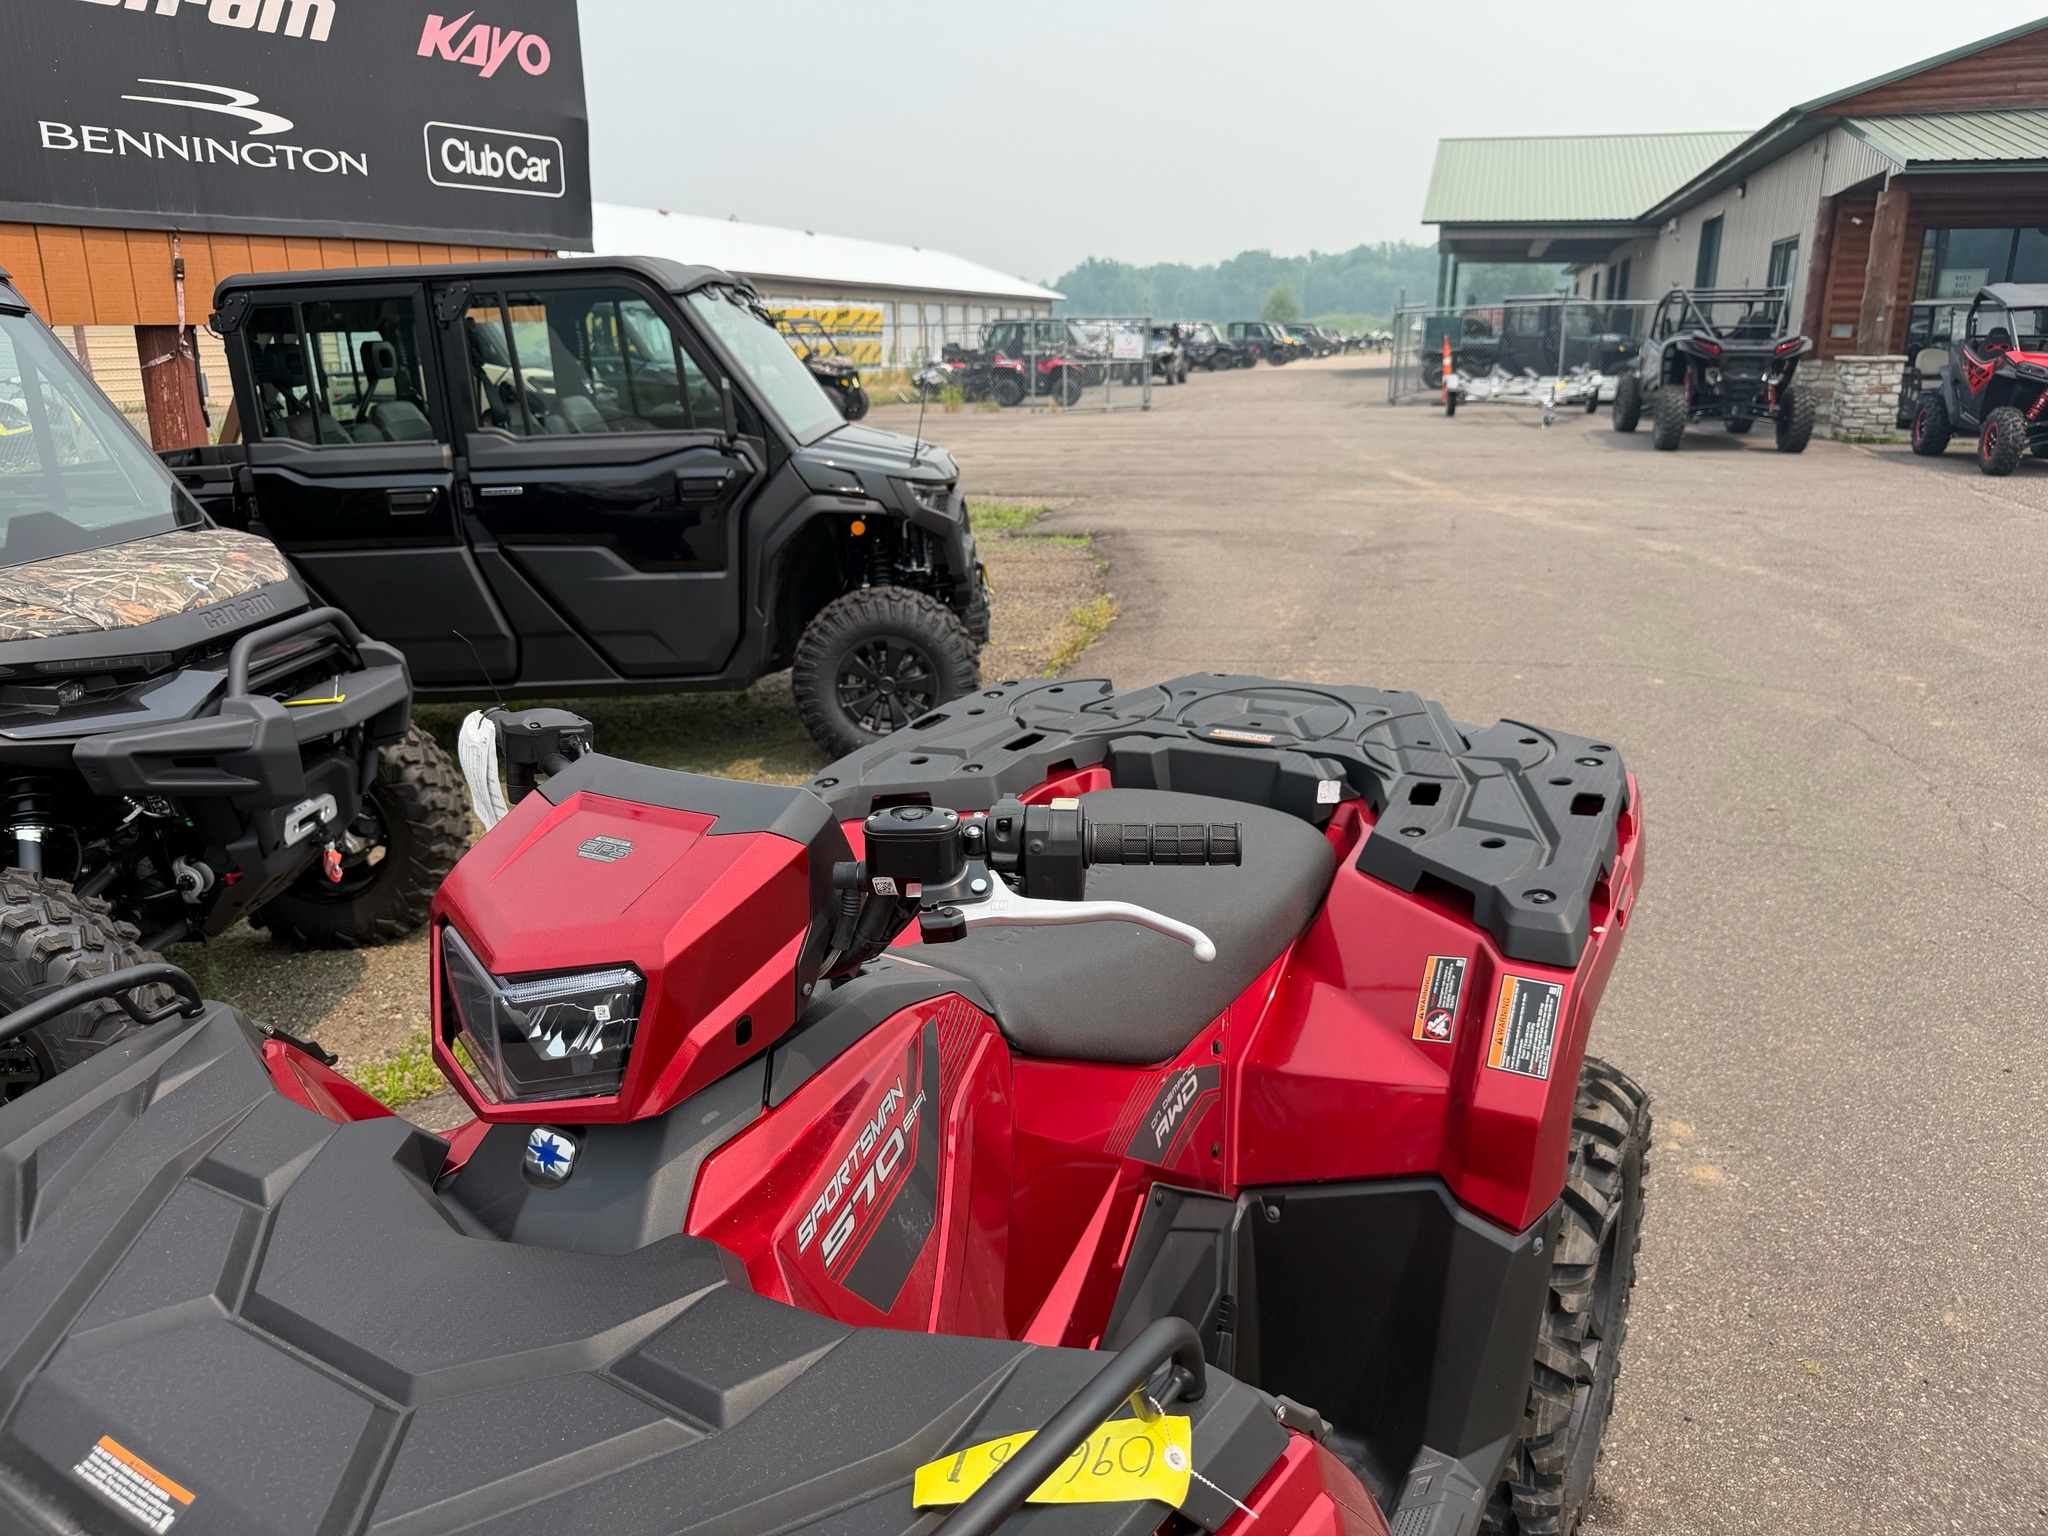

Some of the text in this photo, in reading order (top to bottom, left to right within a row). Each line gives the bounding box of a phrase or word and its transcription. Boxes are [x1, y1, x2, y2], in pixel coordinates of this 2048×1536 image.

[417, 10, 551, 78] KAYO
[38, 121, 368, 177] BENNINGTON
[441, 138, 551, 182] Club Car
[578, 839, 634, 859] EPS
[1418, 976, 1431, 1012] WARNING
[1496, 997, 1511, 1036] WARNING
[1155, 1074, 1198, 1149] AWD
[797, 1075, 905, 1255] SPORTSMAN
[821, 1089, 927, 1269] 570 EFI
